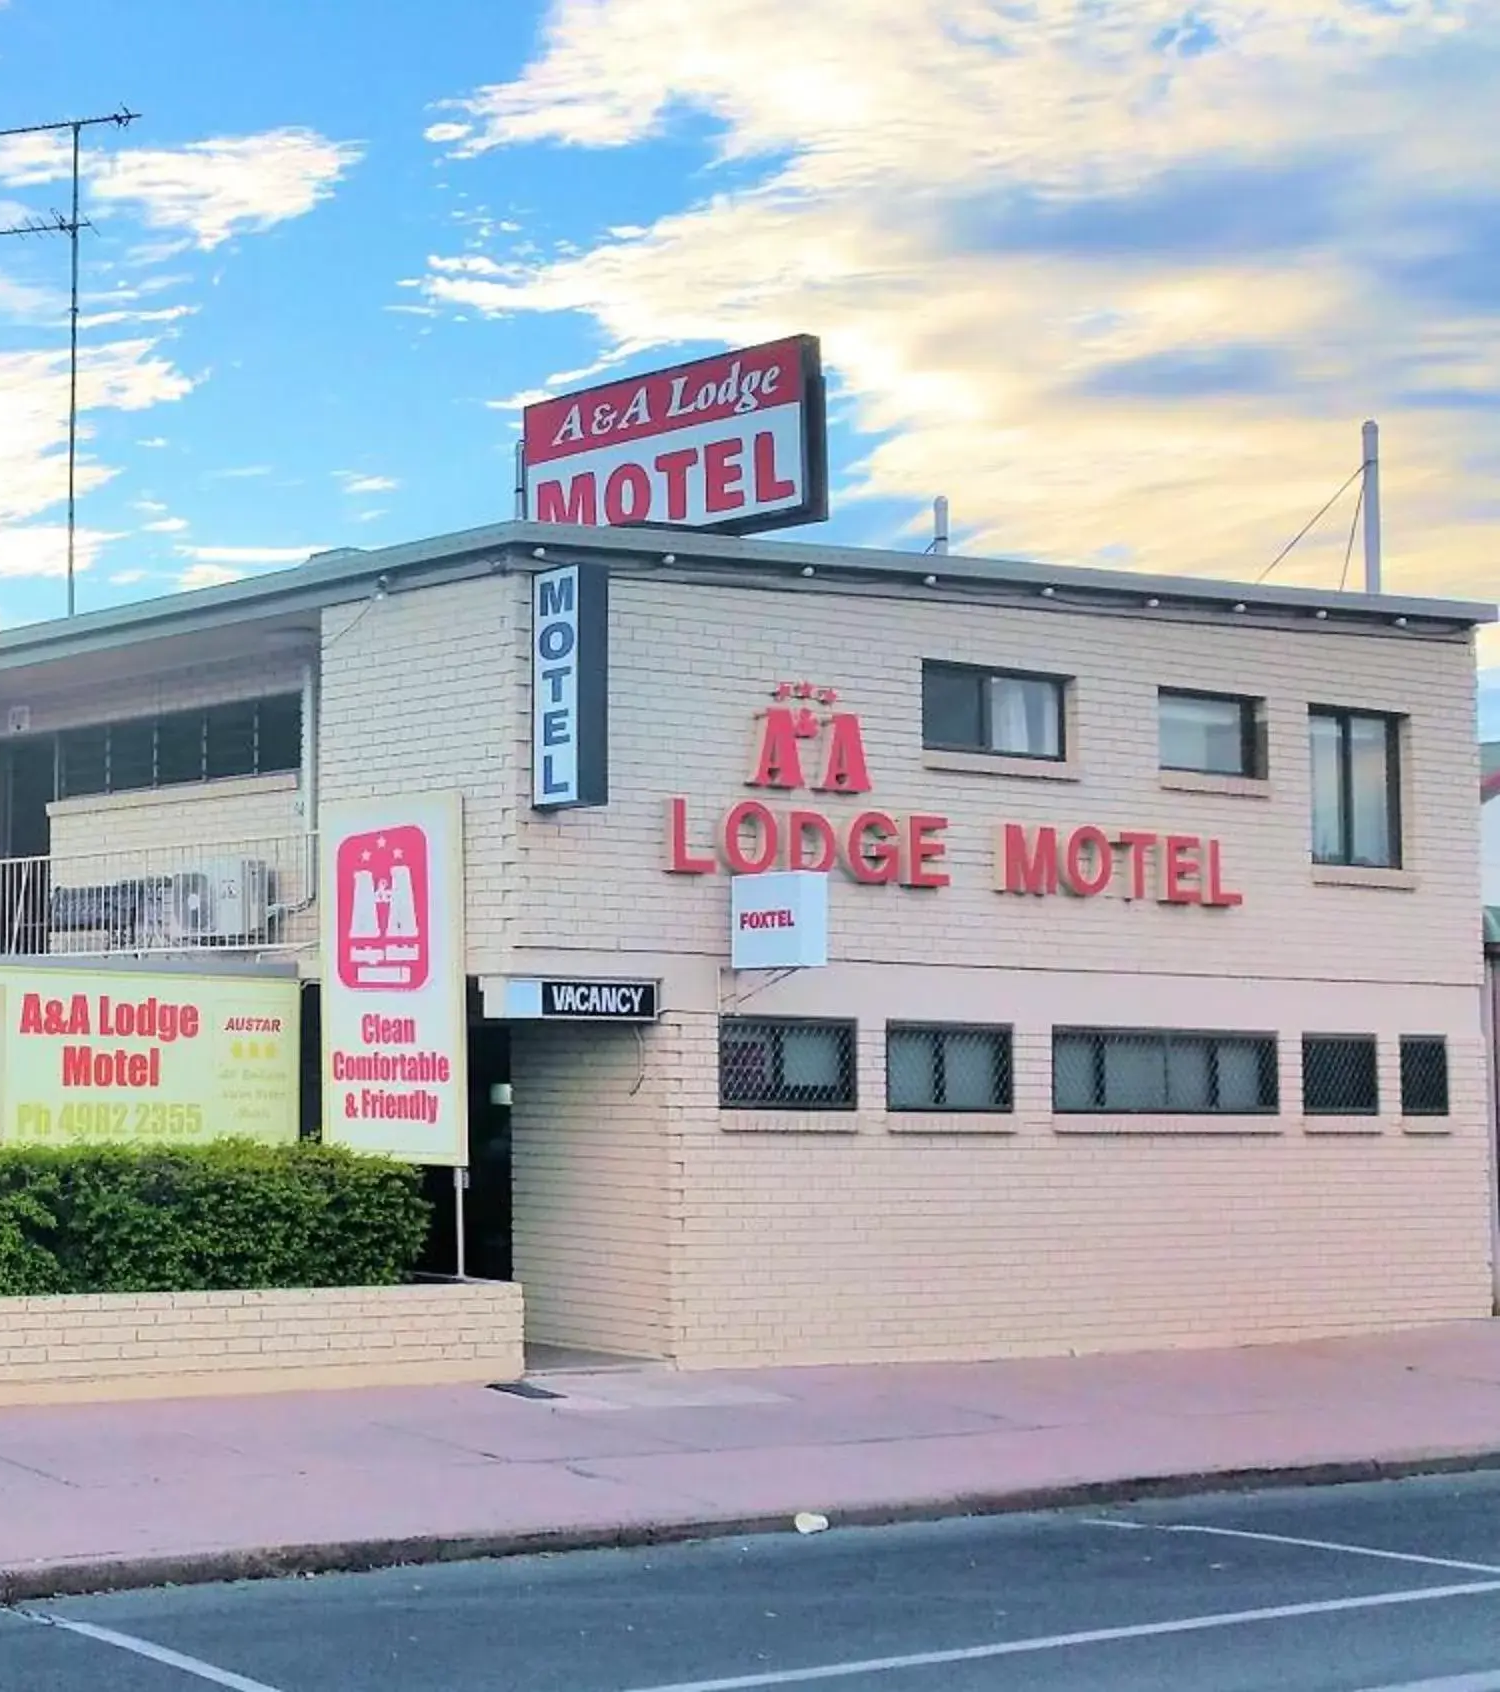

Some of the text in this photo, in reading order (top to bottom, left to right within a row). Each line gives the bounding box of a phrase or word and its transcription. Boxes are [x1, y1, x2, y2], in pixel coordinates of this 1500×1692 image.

[551, 361, 782, 446] A&A Lodge
[536, 431, 795, 526] MOTEL
[539, 580, 575, 795] MOTEL
[665, 798, 1243, 908] LODGE MOTEL
[739, 909, 796, 931] FOXTEL
[19, 992, 199, 1042] A&A Lodge
[551, 984, 644, 1013] VACANCY
[223, 1016, 282, 1033] AUSTAR
[361, 1012, 416, 1045] Clean
[62, 1045, 161, 1087] Motel
[332, 1050, 451, 1083] Comfortable
[17, 1103, 52, 1136] Ph
[58, 1102, 129, 1135] 4982
[135, 1102, 203, 1135] 2355
[344, 1087, 439, 1125] & Friendly
